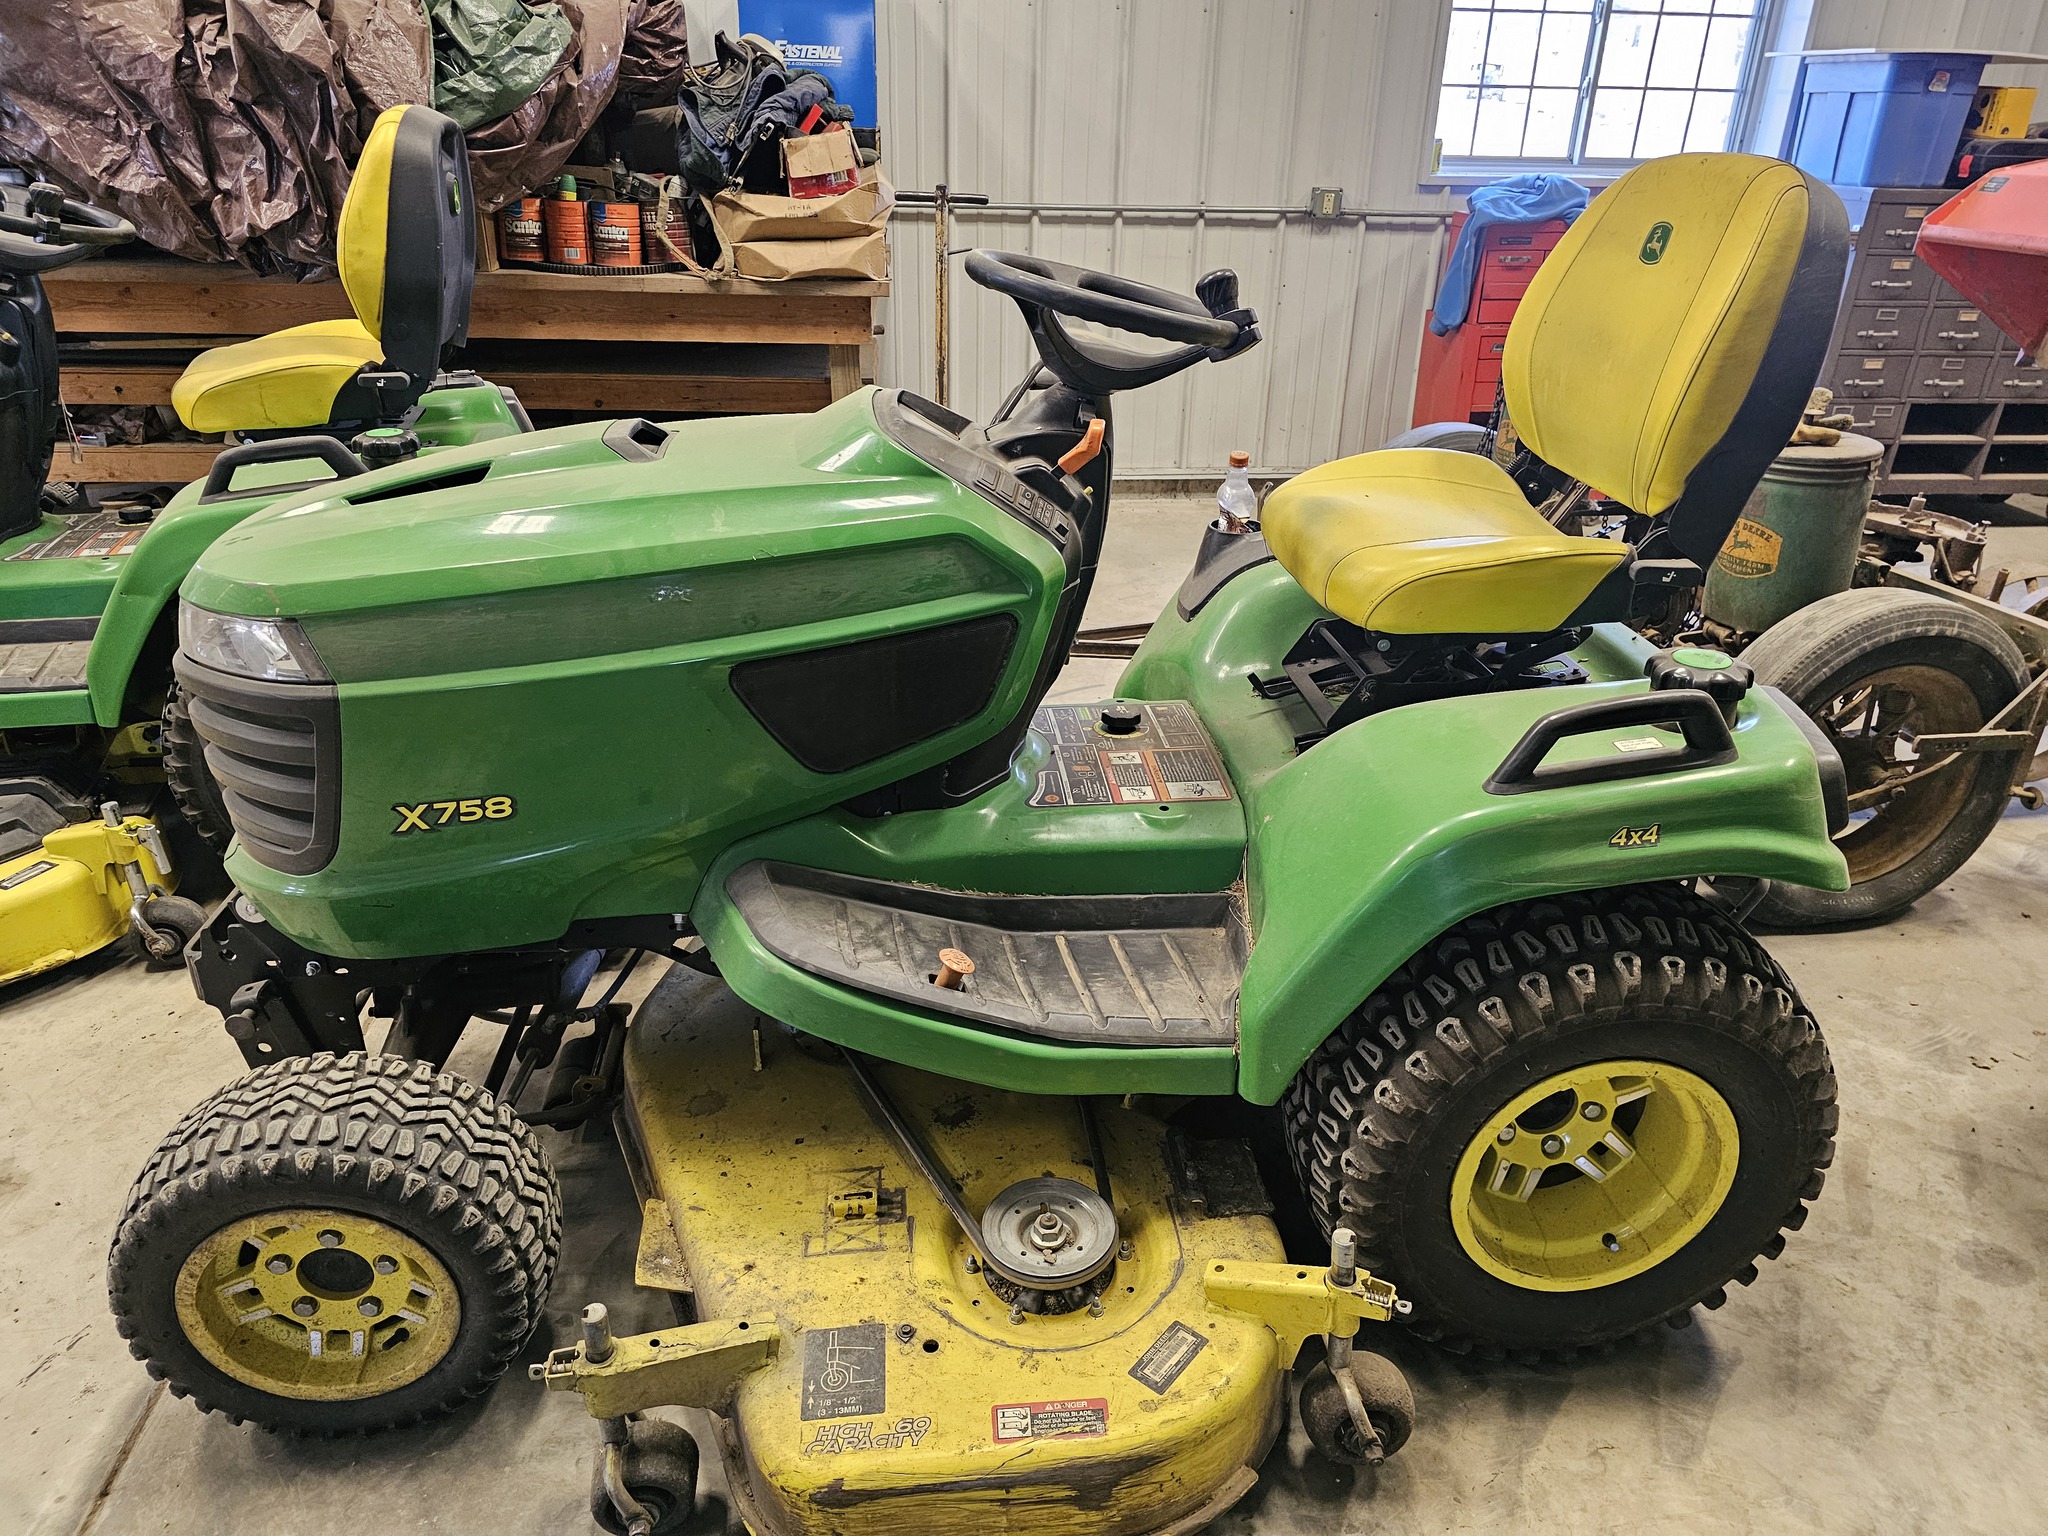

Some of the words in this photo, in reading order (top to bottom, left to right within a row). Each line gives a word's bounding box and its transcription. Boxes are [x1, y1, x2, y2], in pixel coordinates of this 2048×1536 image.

[774, 40, 842, 59] FASTENAL
[504, 217, 543, 235] Sanka
[593, 223, 629, 241] Sanka
[1742, 522, 1773, 543] DEERE
[1743, 560, 1764, 569] FARM
[393, 795, 514, 833] X758
[1610, 824, 1660, 846] 4x4
[834, 1404, 863, 1415] 13MM)
[1038, 1411, 1070, 1419] ROTATING
[816, 1422, 873, 1441] HIGH
[894, 1416, 932, 1434] 60
[804, 1428, 929, 1455] CAPACITY
